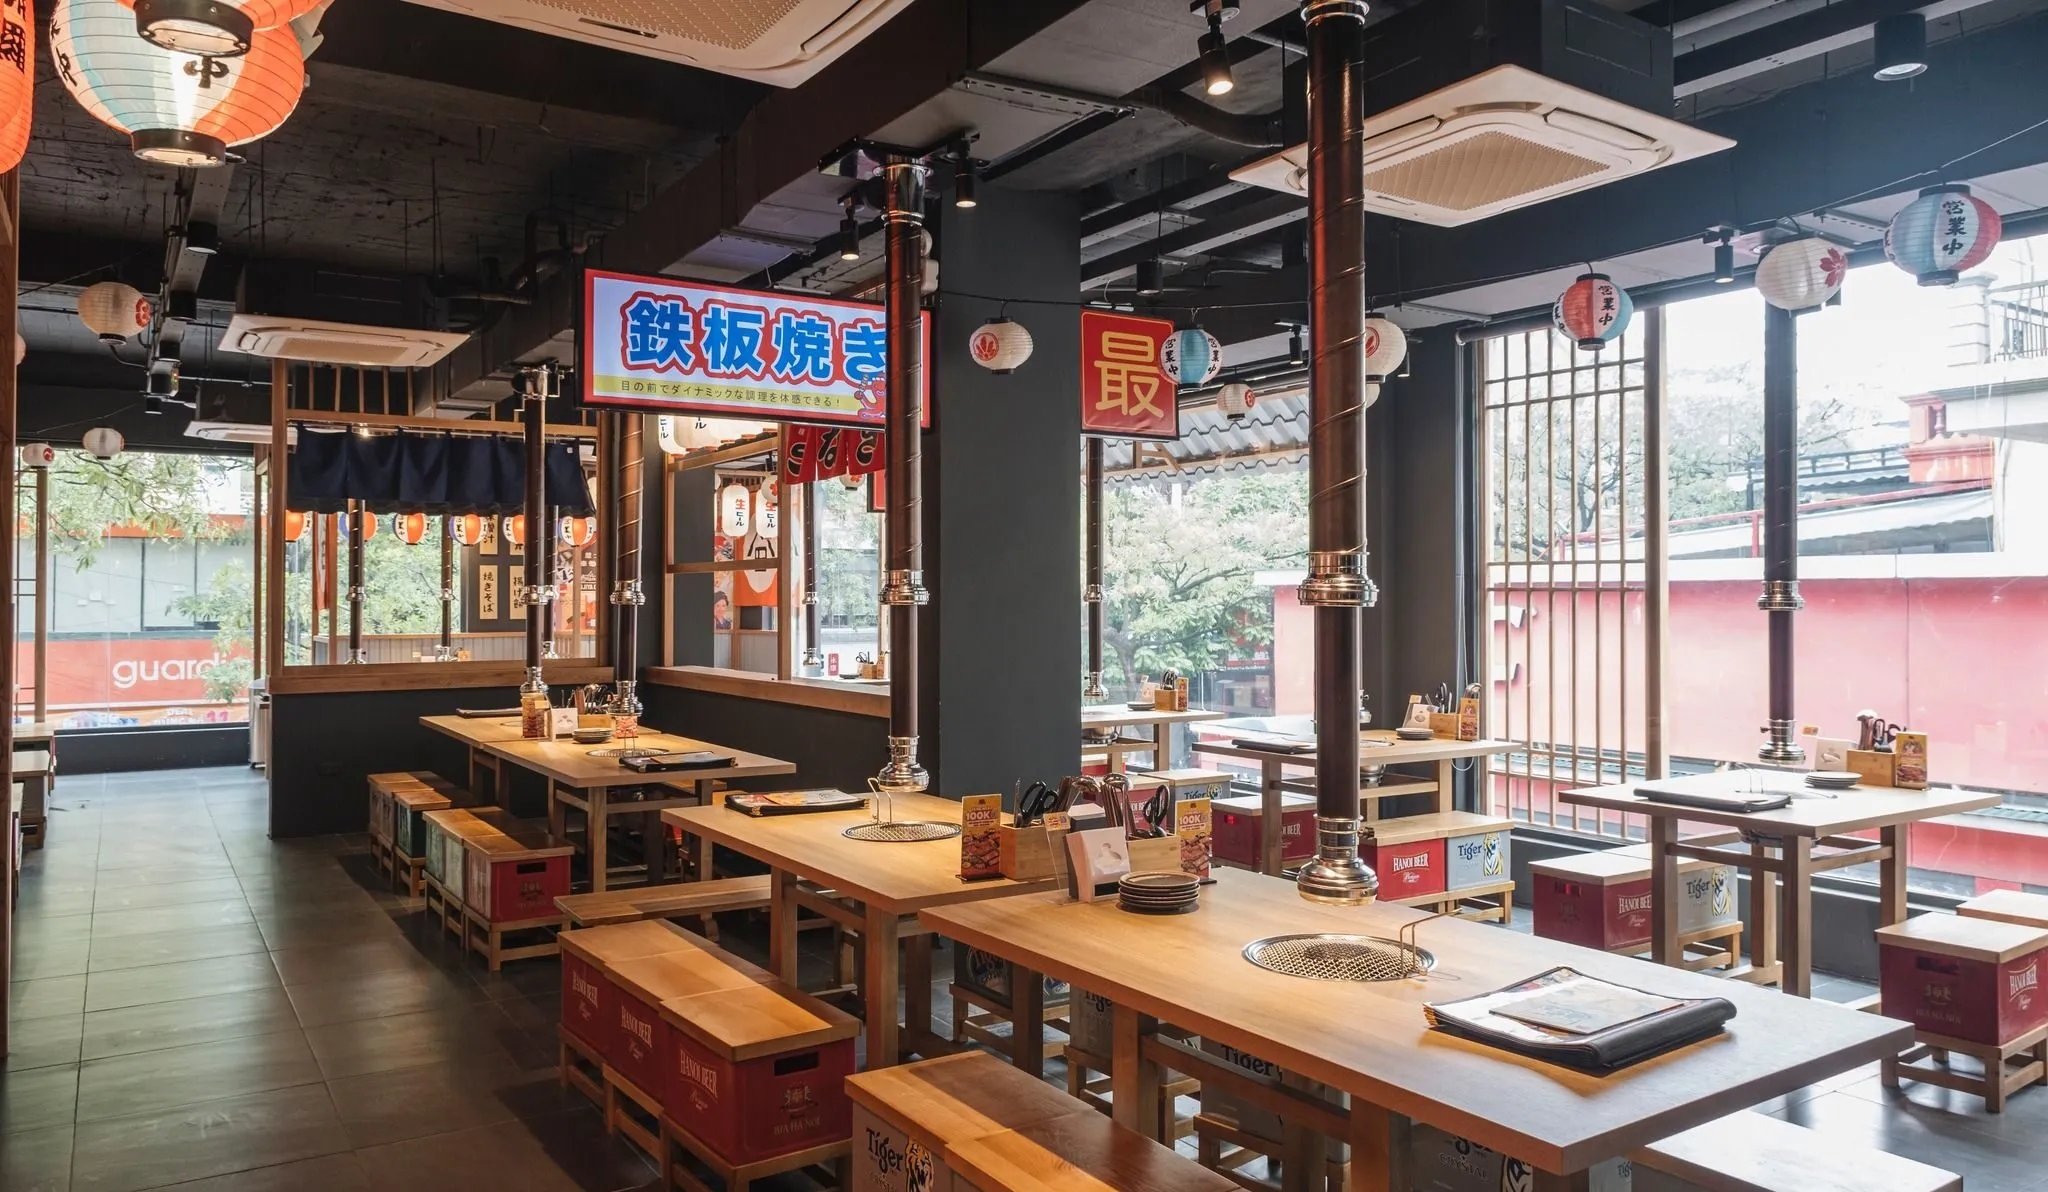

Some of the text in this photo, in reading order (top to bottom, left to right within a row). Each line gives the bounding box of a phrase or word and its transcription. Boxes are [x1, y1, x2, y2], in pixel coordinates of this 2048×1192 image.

[1942, 199, 1967, 256] 営業中
[1597, 285, 1616, 326] 営業中
[627, 298, 887, 386] 鉄板焼き
[1094, 331, 1165, 418] 最
[112, 651, 226, 689] guard
[1393, 853, 1429, 872] HANOI BEER
[1458, 842, 1483, 860] Tiger
[1618, 896, 1640, 914] HANOI
[1686, 878, 1710, 899] Tiger
[2009, 972, 2026, 996] HANOI
[621, 1004, 638, 1034] HANOI
[638, 1020, 653, 1048] BEER
[680, 1048, 701, 1082] HANOI
[701, 1066, 718, 1099] BEER
[866, 1126, 904, 1174] Tiger
[1617, 1160, 1632, 1178] Tig
